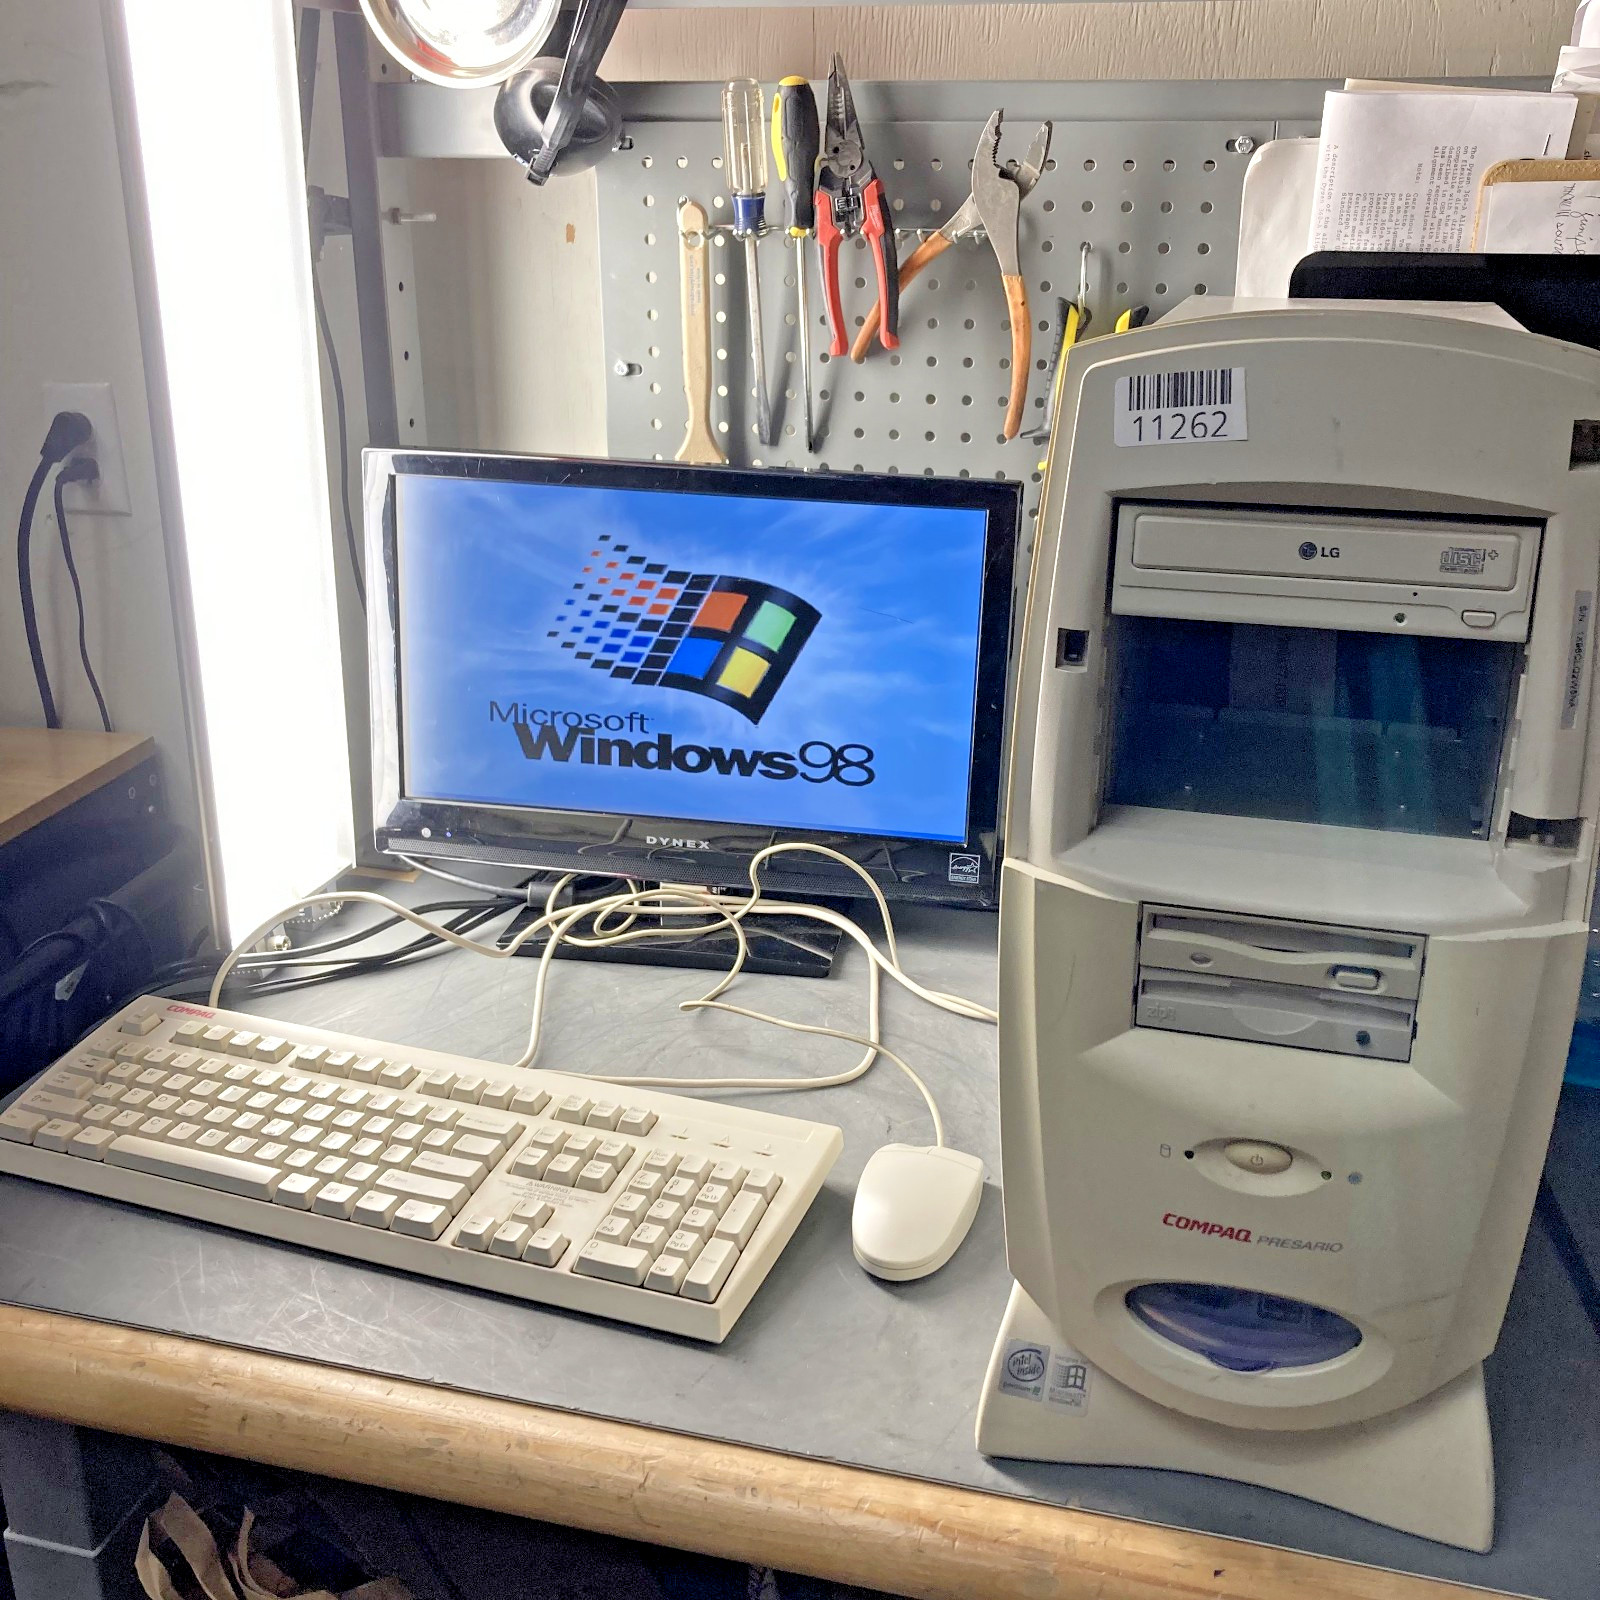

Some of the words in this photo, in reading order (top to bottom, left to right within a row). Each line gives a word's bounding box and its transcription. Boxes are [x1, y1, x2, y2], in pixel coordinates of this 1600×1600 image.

[1327, 154, 1338, 200] description
[1429, 146, 1439, 185] alignment
[1443, 146, 1455, 184] described
[1450, 146, 1461, 189] compatible
[1457, 160, 1467, 193] flexible
[1338, 192, 1347, 226] Standard
[1344, 192, 1353, 230] paragraph
[1353, 193, 1361, 222] feature
[1359, 206, 1367, 226] those
[1365, 193, 1375, 235] protective
[1372, 193, 1383, 238] inadvertent
[1388, 193, 1396, 222] punched
[1423, 189, 1432, 231] operations
[1431, 185, 1440, 218] recorded
[1407, 214, 1415, 239] should
[1455, 215, 1466, 252] Alignment
[1133, 410, 1228, 441] 11262
[1321, 547, 1340, 558] LG
[489, 701, 650, 734] Microsoft
[646, 836, 710, 849] DYNEX
[167, 1004, 216, 1019] COMPAQ
[1163, 1213, 1251, 1243] COMPAQ
[1257, 1235, 1344, 1253] PRESARIO
